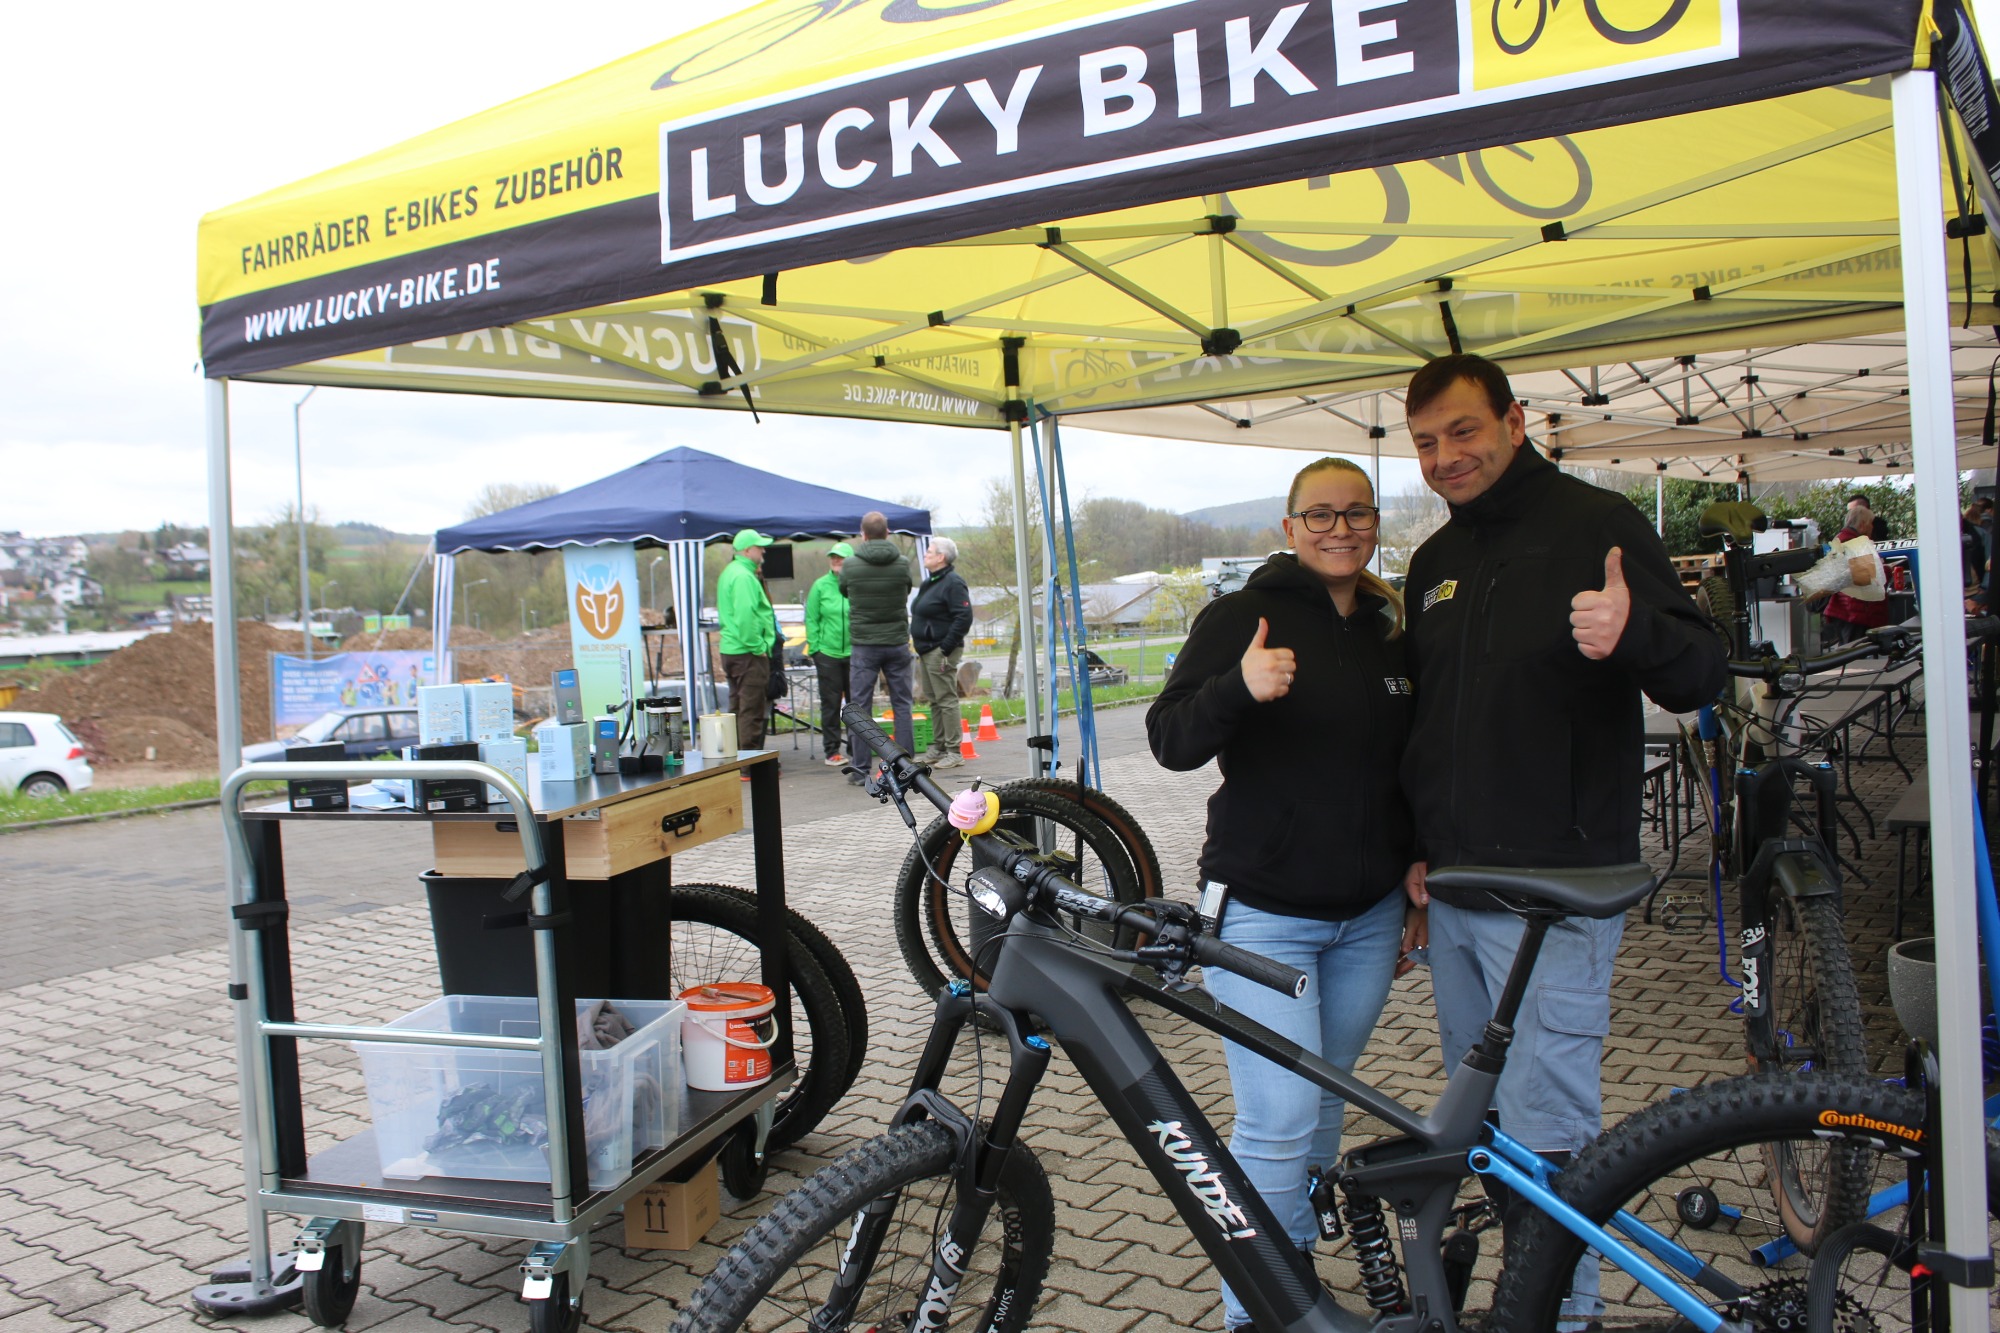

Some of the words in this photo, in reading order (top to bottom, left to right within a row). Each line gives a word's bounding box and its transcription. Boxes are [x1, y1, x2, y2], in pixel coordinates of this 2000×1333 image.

[690, 65, 1044, 222] LUCKY
[1079, 0, 1416, 137] BIKE
[241, 214, 370, 275] FAHRRÄDER
[384, 185, 478, 236] E-BIKES
[494, 146, 623, 210] ZUBEHÖR
[244, 258, 500, 343] WWW.LUCKY-BIKE.DE
[1742, 956, 1759, 1008] FOX
[1818, 1109, 1923, 1142] Continental
[1321, 1211, 1336, 1234] FOX
[1399, 1218, 1416, 1228] 140
[994, 1287, 1015, 1323] SWISS
